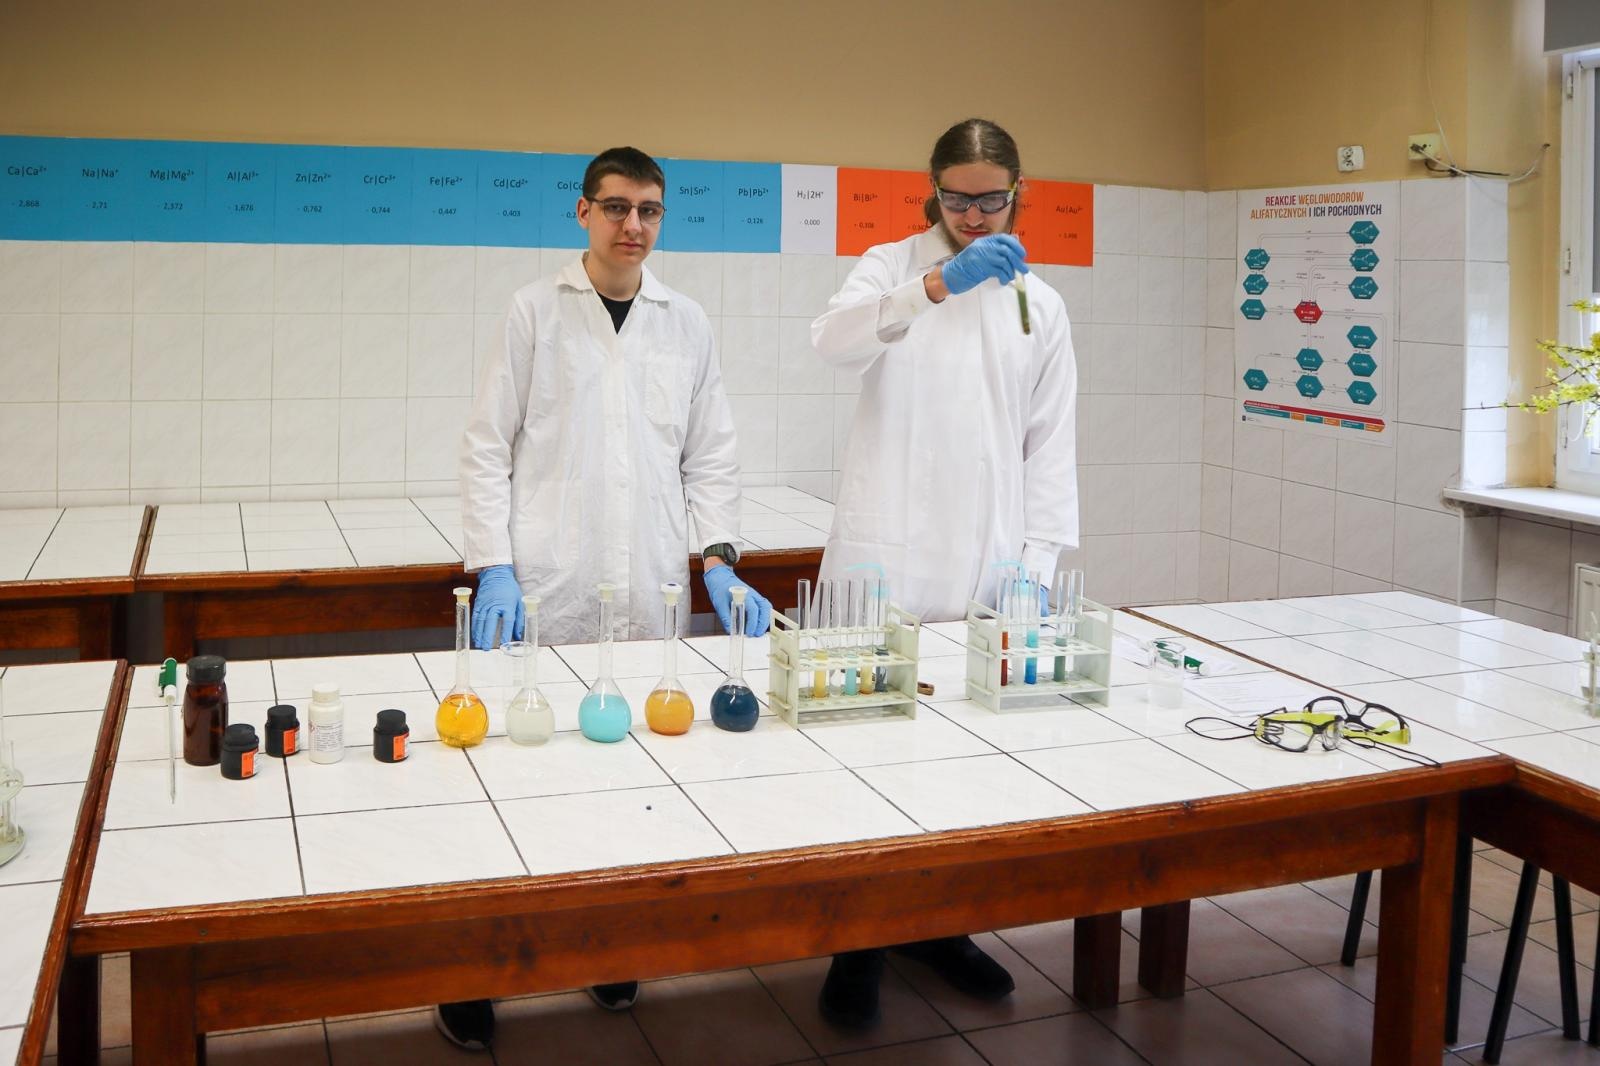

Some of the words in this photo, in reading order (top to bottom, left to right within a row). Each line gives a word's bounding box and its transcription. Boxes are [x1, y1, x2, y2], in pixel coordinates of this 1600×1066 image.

[91, 201, 108, 209] 2,71
[1265, 195, 1296, 206] REAKCJE
[1298, 191, 1364, 205] WĘGLOWODORÓW
[1250, 207, 1307, 219] ALIFATYCZNYCH
[1313, 206, 1326, 217] ICH
[1328, 204, 1382, 217] POCHODNYCH
